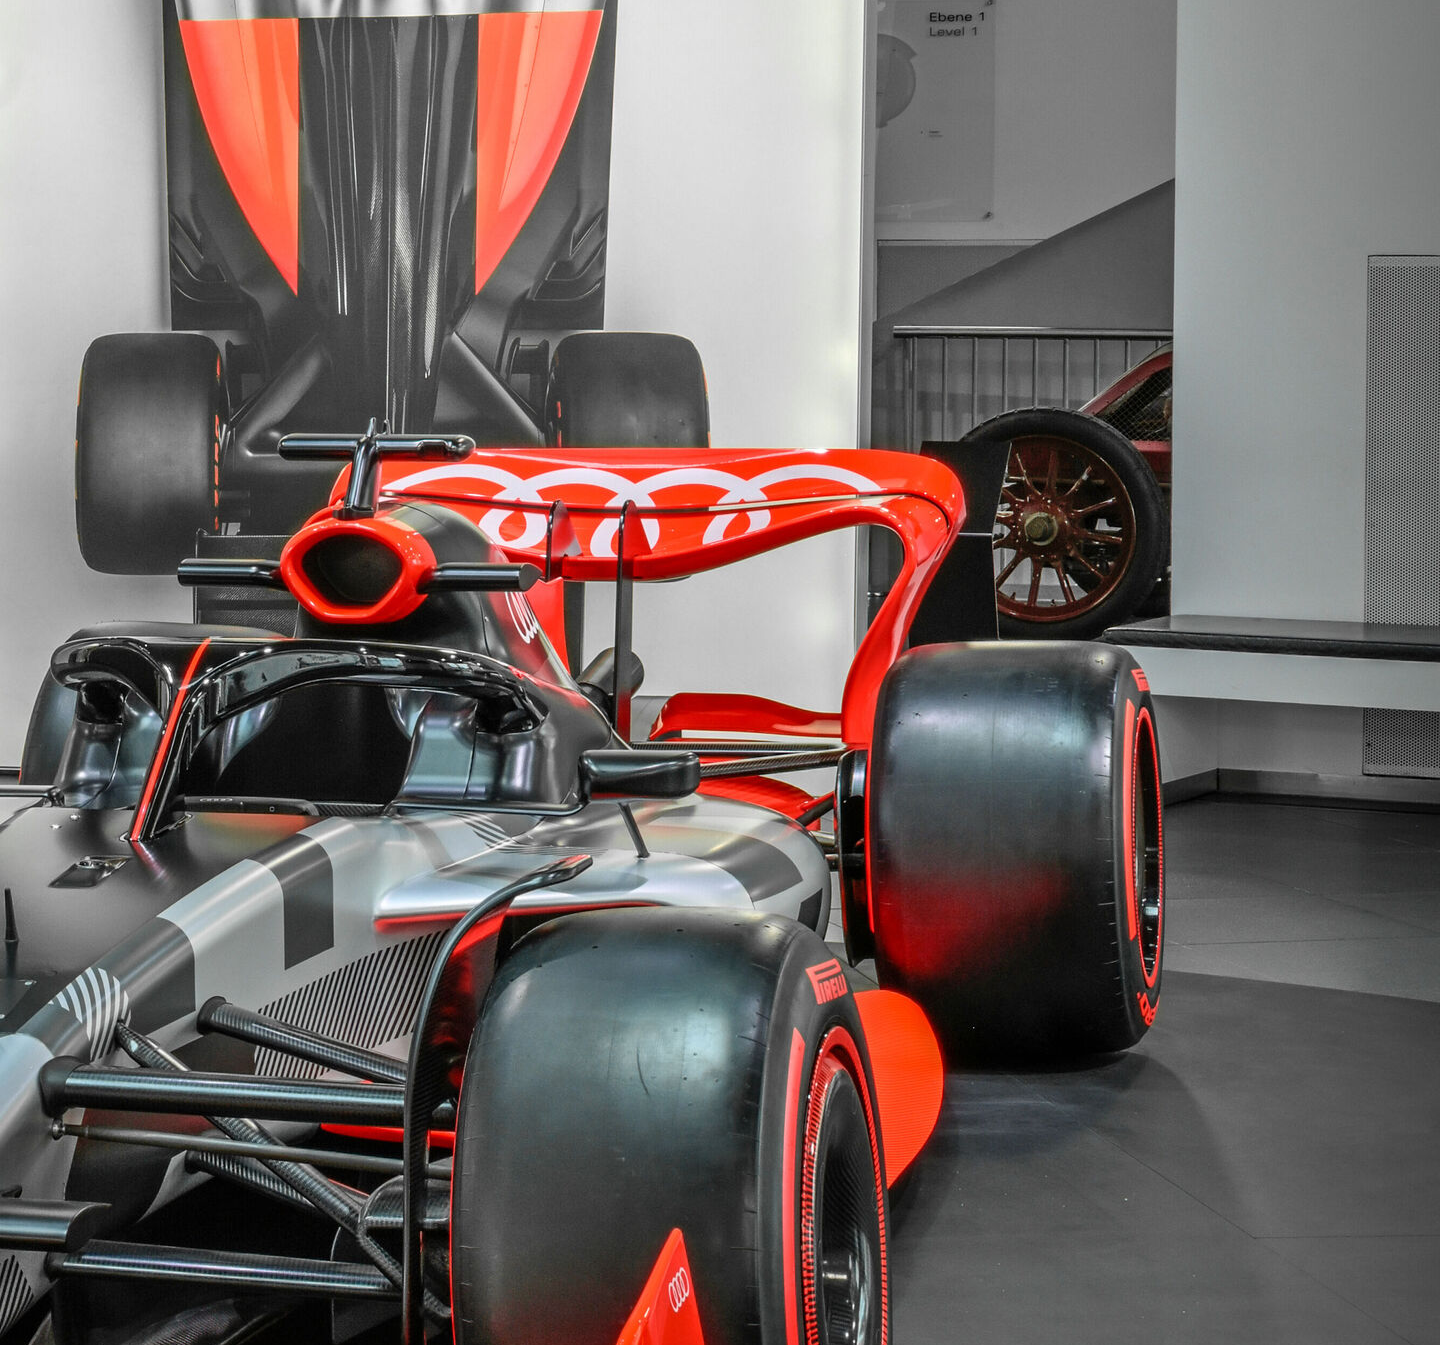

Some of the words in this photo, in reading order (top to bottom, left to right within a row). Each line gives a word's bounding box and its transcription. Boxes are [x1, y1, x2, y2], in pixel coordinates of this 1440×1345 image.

[929, 12, 973, 22] Ebene
[979, 11, 985, 21] 1
[929, 26, 965, 37] Level
[972, 26, 977, 36] 1
